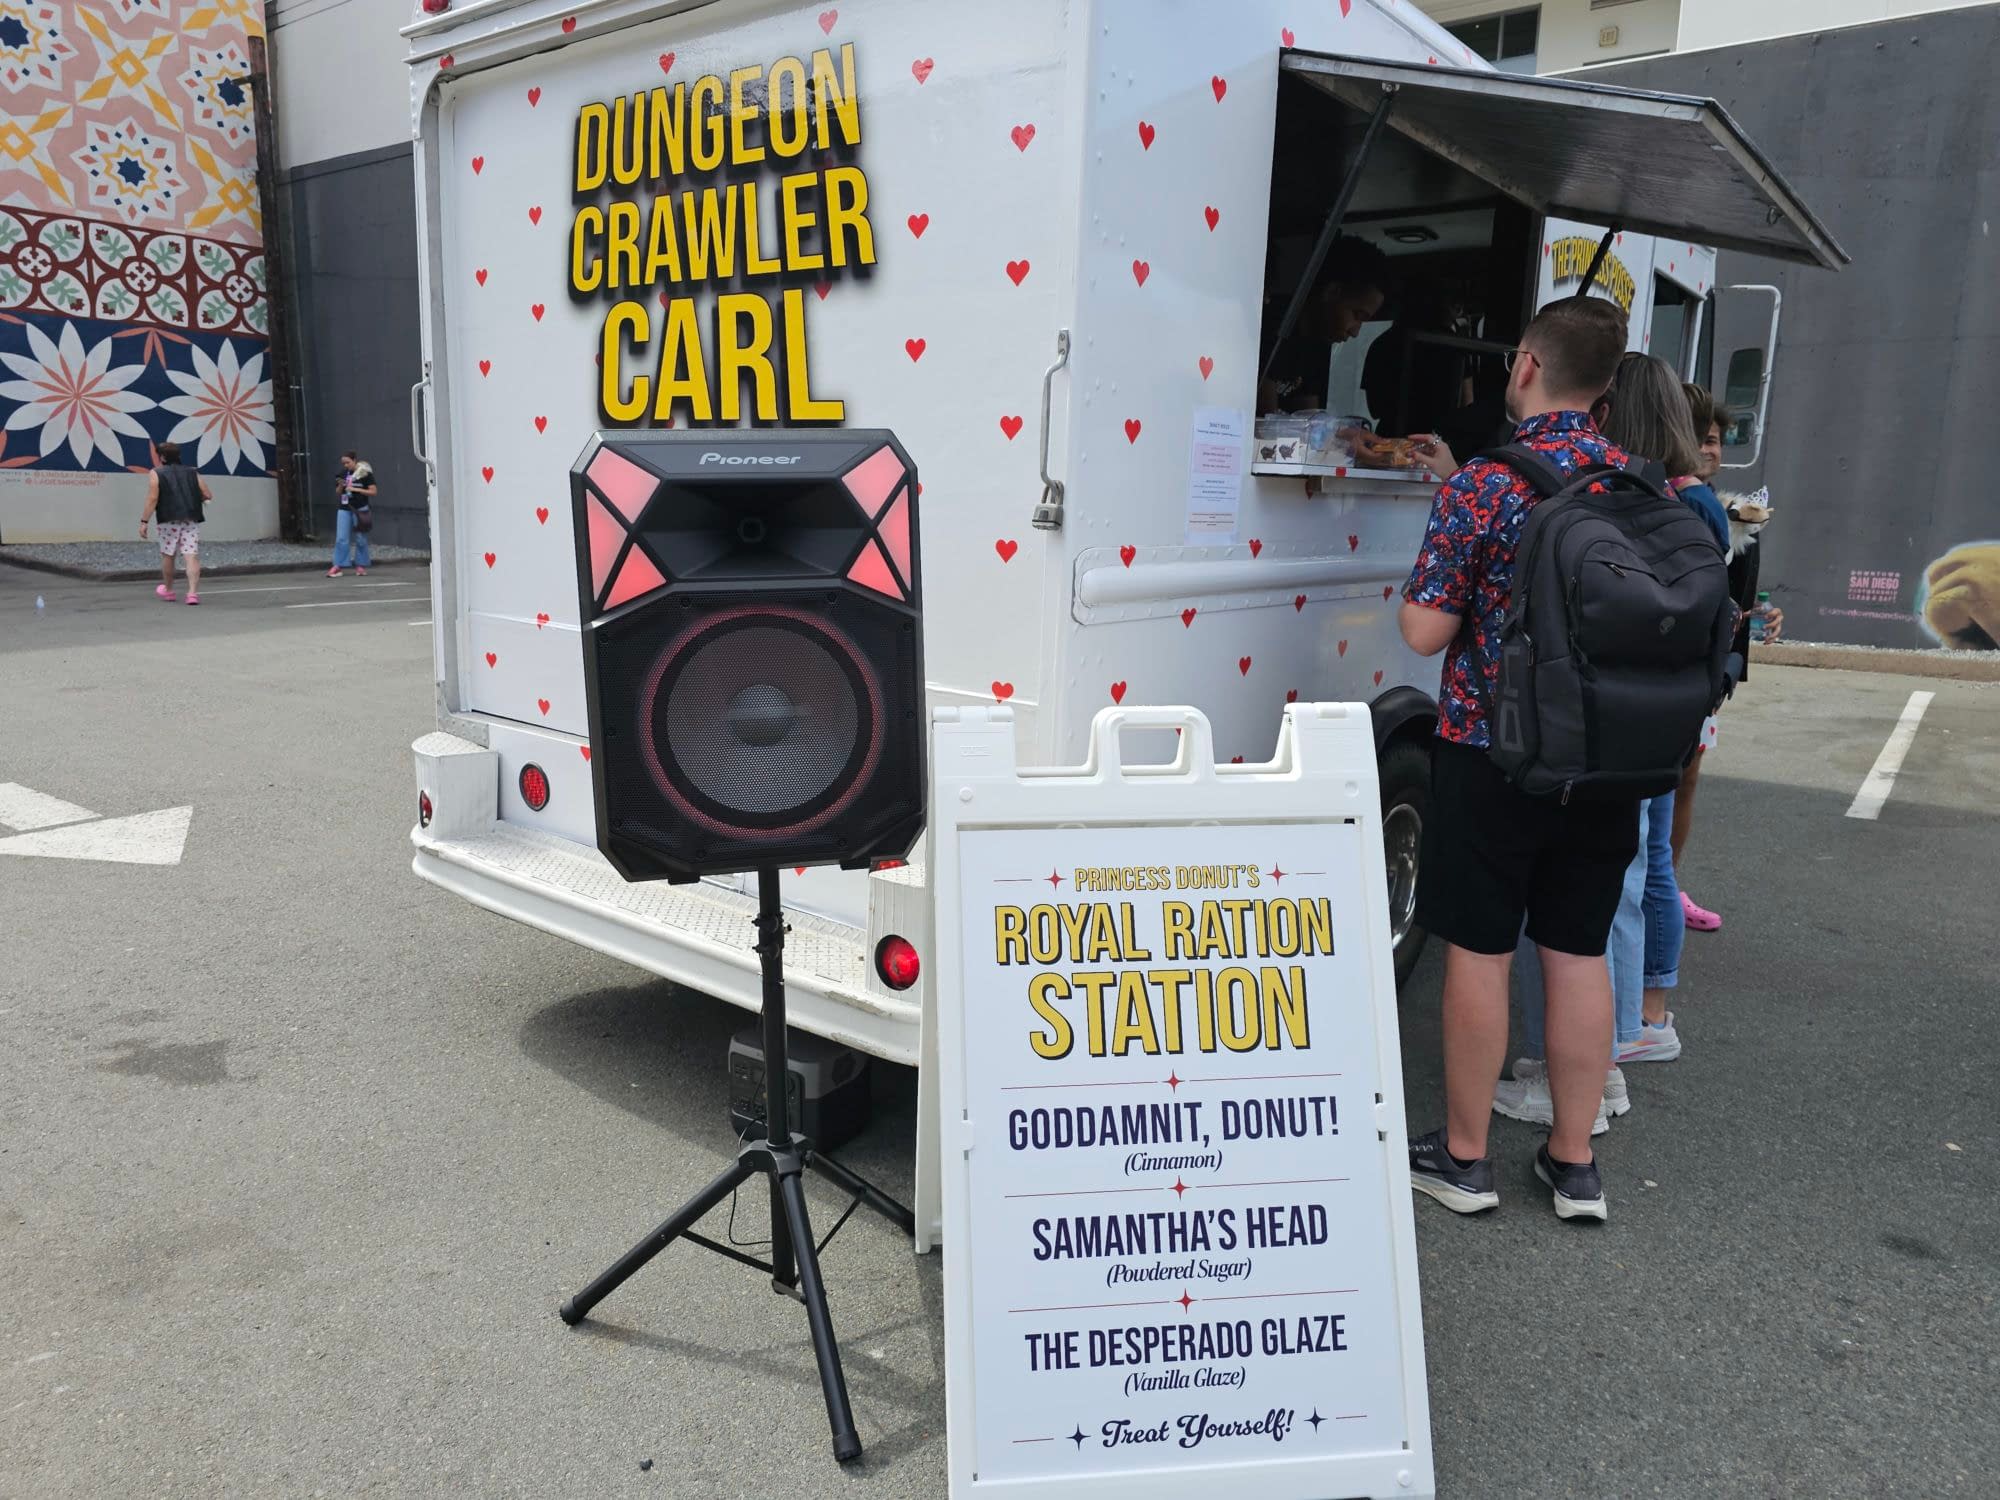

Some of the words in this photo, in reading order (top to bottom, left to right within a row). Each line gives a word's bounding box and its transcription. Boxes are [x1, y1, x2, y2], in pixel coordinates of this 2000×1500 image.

[576, 42, 861, 192] DUNGEON
[572, 166, 878, 292] CRAWLER
[1552, 239, 1570, 281] THE
[1571, 238, 1612, 287] PRINCSS
[601, 288, 846, 422] CARL
[699, 452, 801, 465] Pioneer
[1850, 576, 1869, 588] SAN
[1871, 577, 1899, 589] DIEGO
[1074, 866, 1170, 892] PRINCESS
[994, 902, 1152, 966] ROYAL
[1162, 897, 1335, 960] RATION
[1028, 965, 1311, 1060] STATION
[1008, 1101, 1210, 1150] GODDAMNIT,
[1221, 1095, 1340, 1141] DONUT!
[1124, 1149, 1223, 1176] (Cinnamon)
[1246, 1204, 1329, 1249] HEAD
[1106, 1260, 1194, 1288] (Powdered
[1197, 1257, 1252, 1282] Sugar)
[1025, 1331, 1080, 1371] THE
[1088, 1320, 1253, 1368] DESPERADO
[1261, 1314, 1348, 1357] GLAZE
[1124, 1368, 1190, 1397] (Vanilla
[1193, 1365, 1246, 1390] Glaze)
[1101, 1419, 1170, 1448] Treat
[1176, 1408, 1295, 1449] Yourself!
